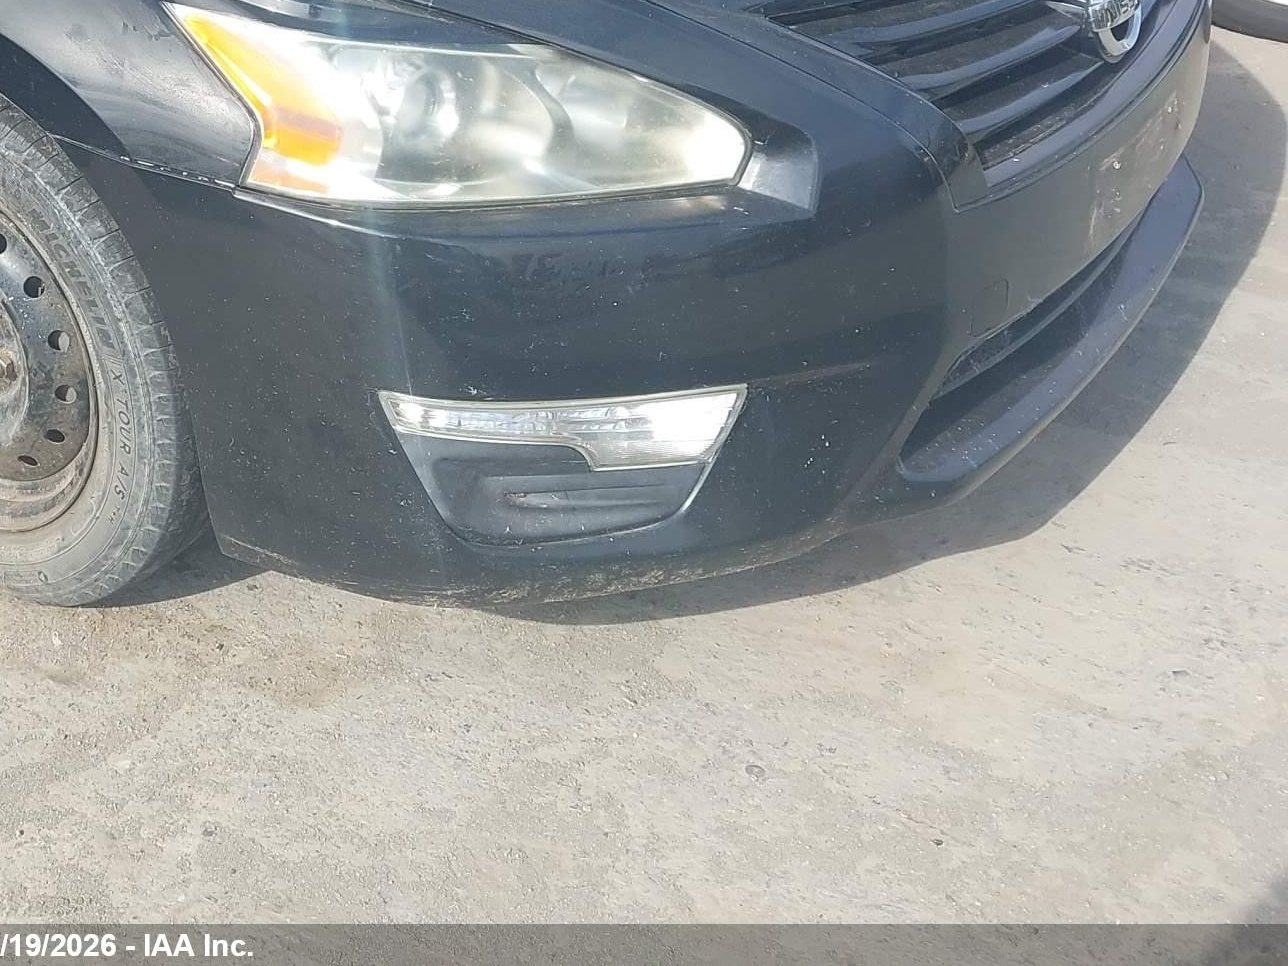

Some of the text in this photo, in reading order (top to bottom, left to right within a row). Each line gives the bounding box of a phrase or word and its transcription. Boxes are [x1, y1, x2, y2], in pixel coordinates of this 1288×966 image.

[111, 369, 125, 385] X
[116, 398, 131, 455] TOUR
[114, 461, 129, 500] A/S
